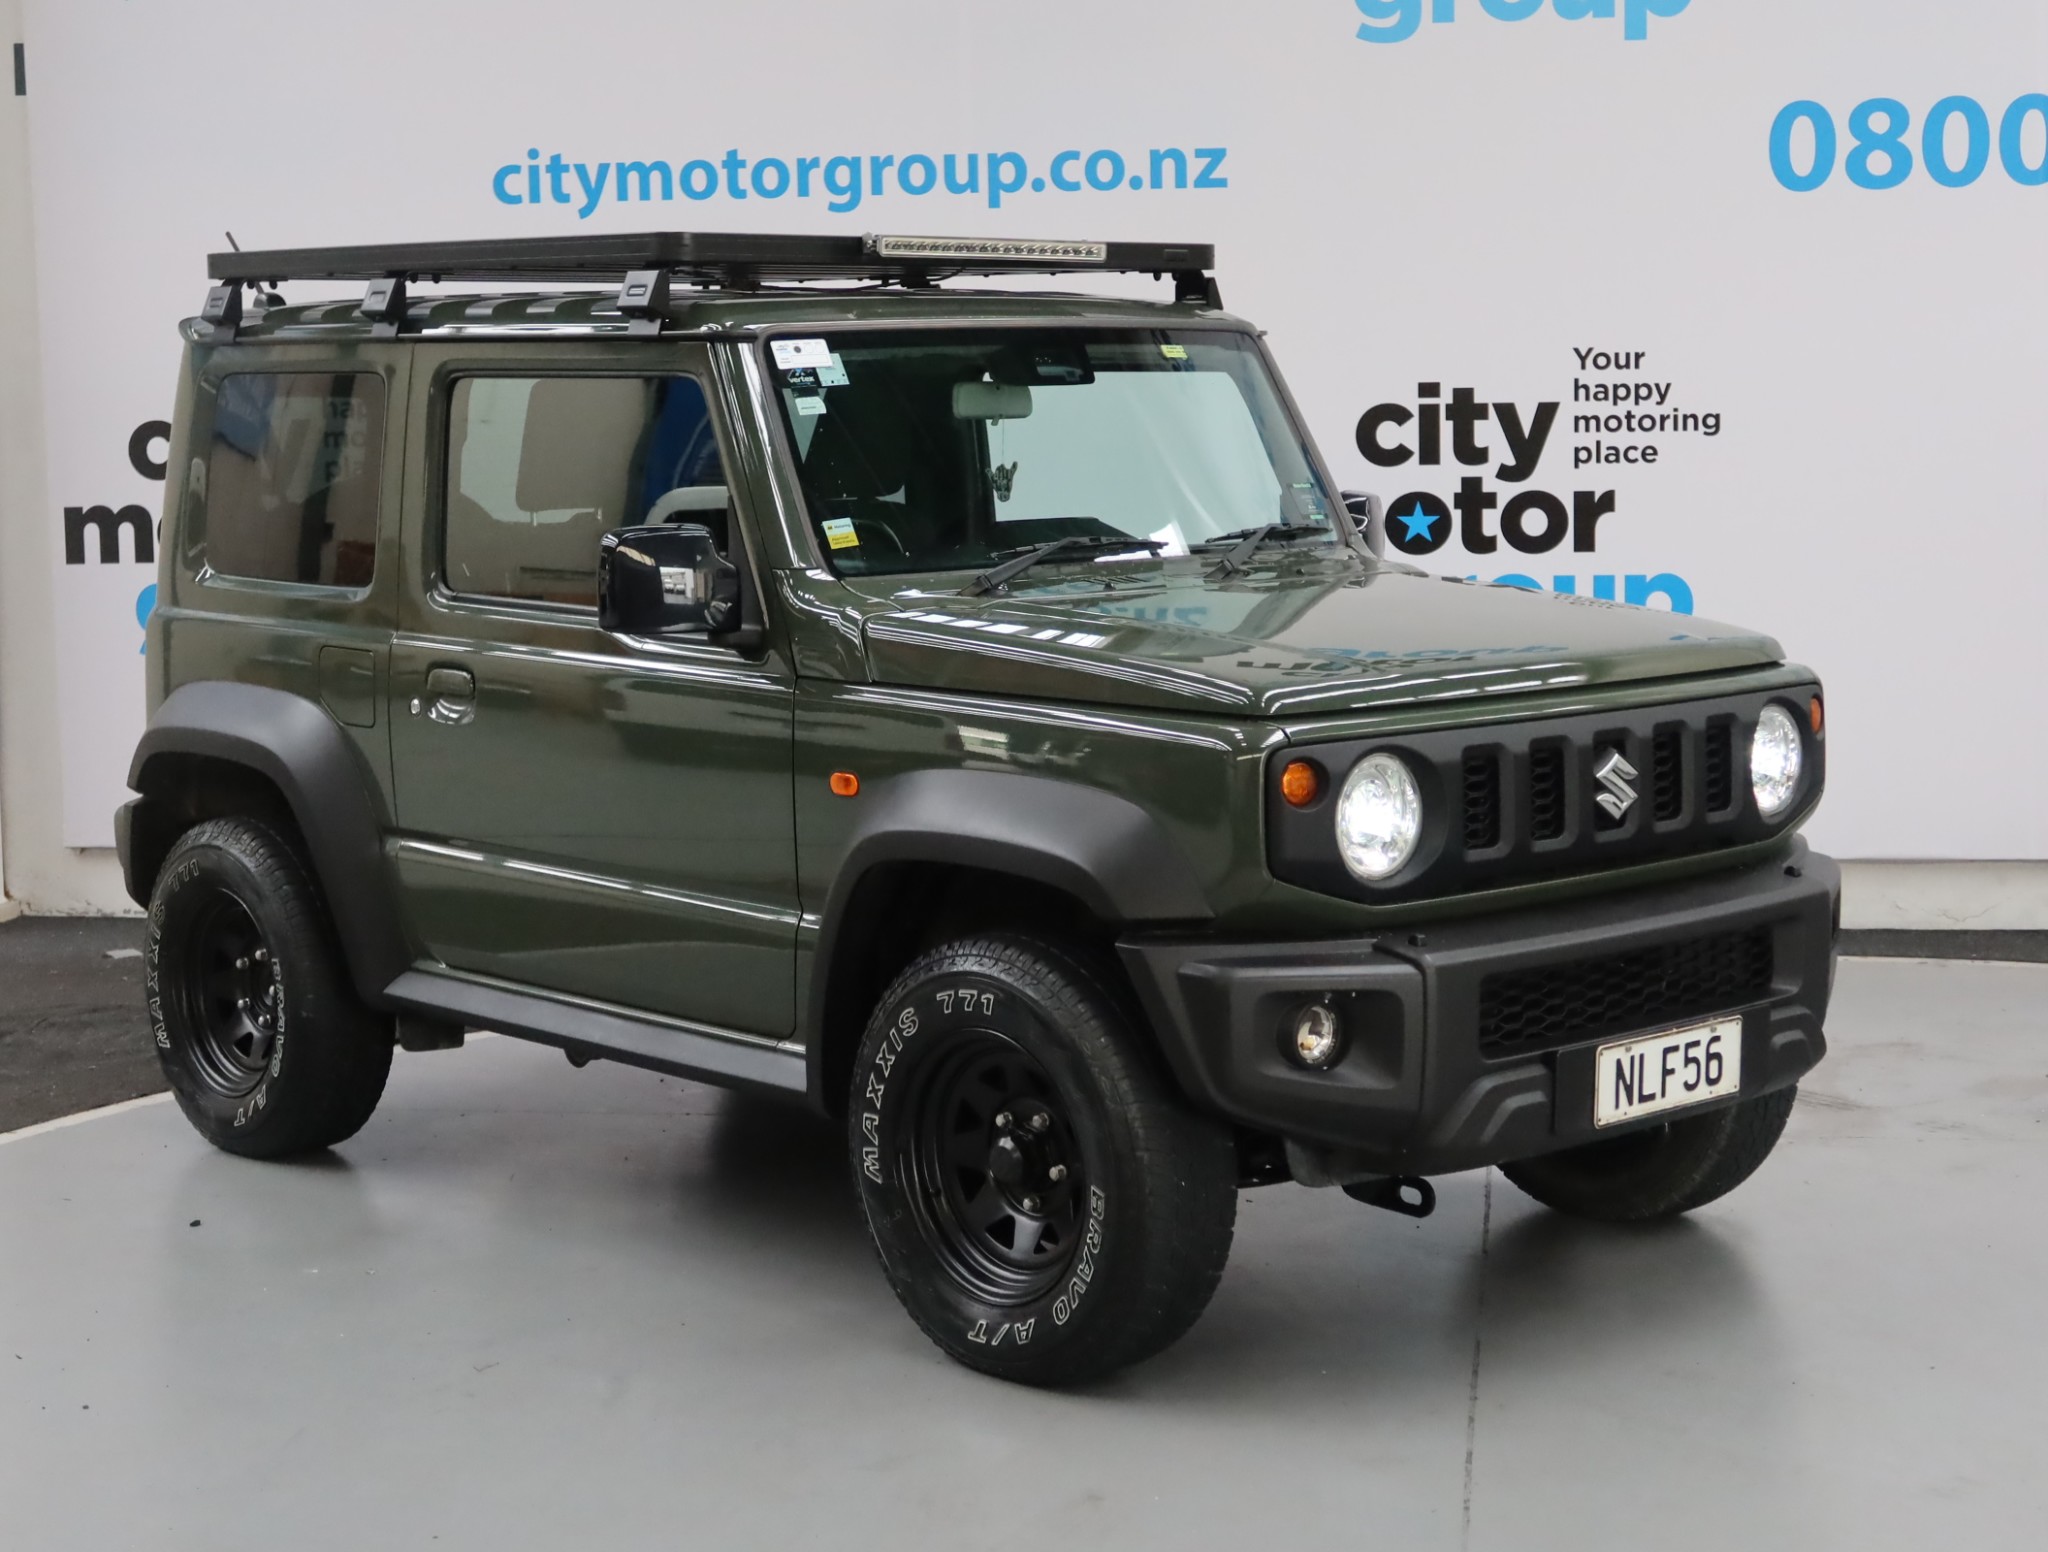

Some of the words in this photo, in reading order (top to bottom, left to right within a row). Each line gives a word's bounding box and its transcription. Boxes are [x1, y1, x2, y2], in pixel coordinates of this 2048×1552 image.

[1769, 93, 2048, 192] 0800
[493, 147, 1228, 217] citymotorgroup.co.nz
[1573, 347, 1646, 371] Your
[1573, 378, 1671, 406] happy
[1356, 382, 1560, 482] city
[1573, 408, 1721, 435] motoring
[1573, 440, 1658, 468] place
[1385, 477, 1615, 555] otor
[147, 900, 171, 1049] MAXXIS
[168, 858, 200, 892] 771
[271, 958, 285, 1077] BRAVO
[234, 1084, 266, 1127] A/T
[862, 1007, 919, 1185] MAXXIS
[936, 988, 995, 1016] 771
[1614, 1034, 1724, 1110] NLF56
[1052, 1184, 1105, 1325] BRAVO
[967, 1318, 1036, 1346] A/T
